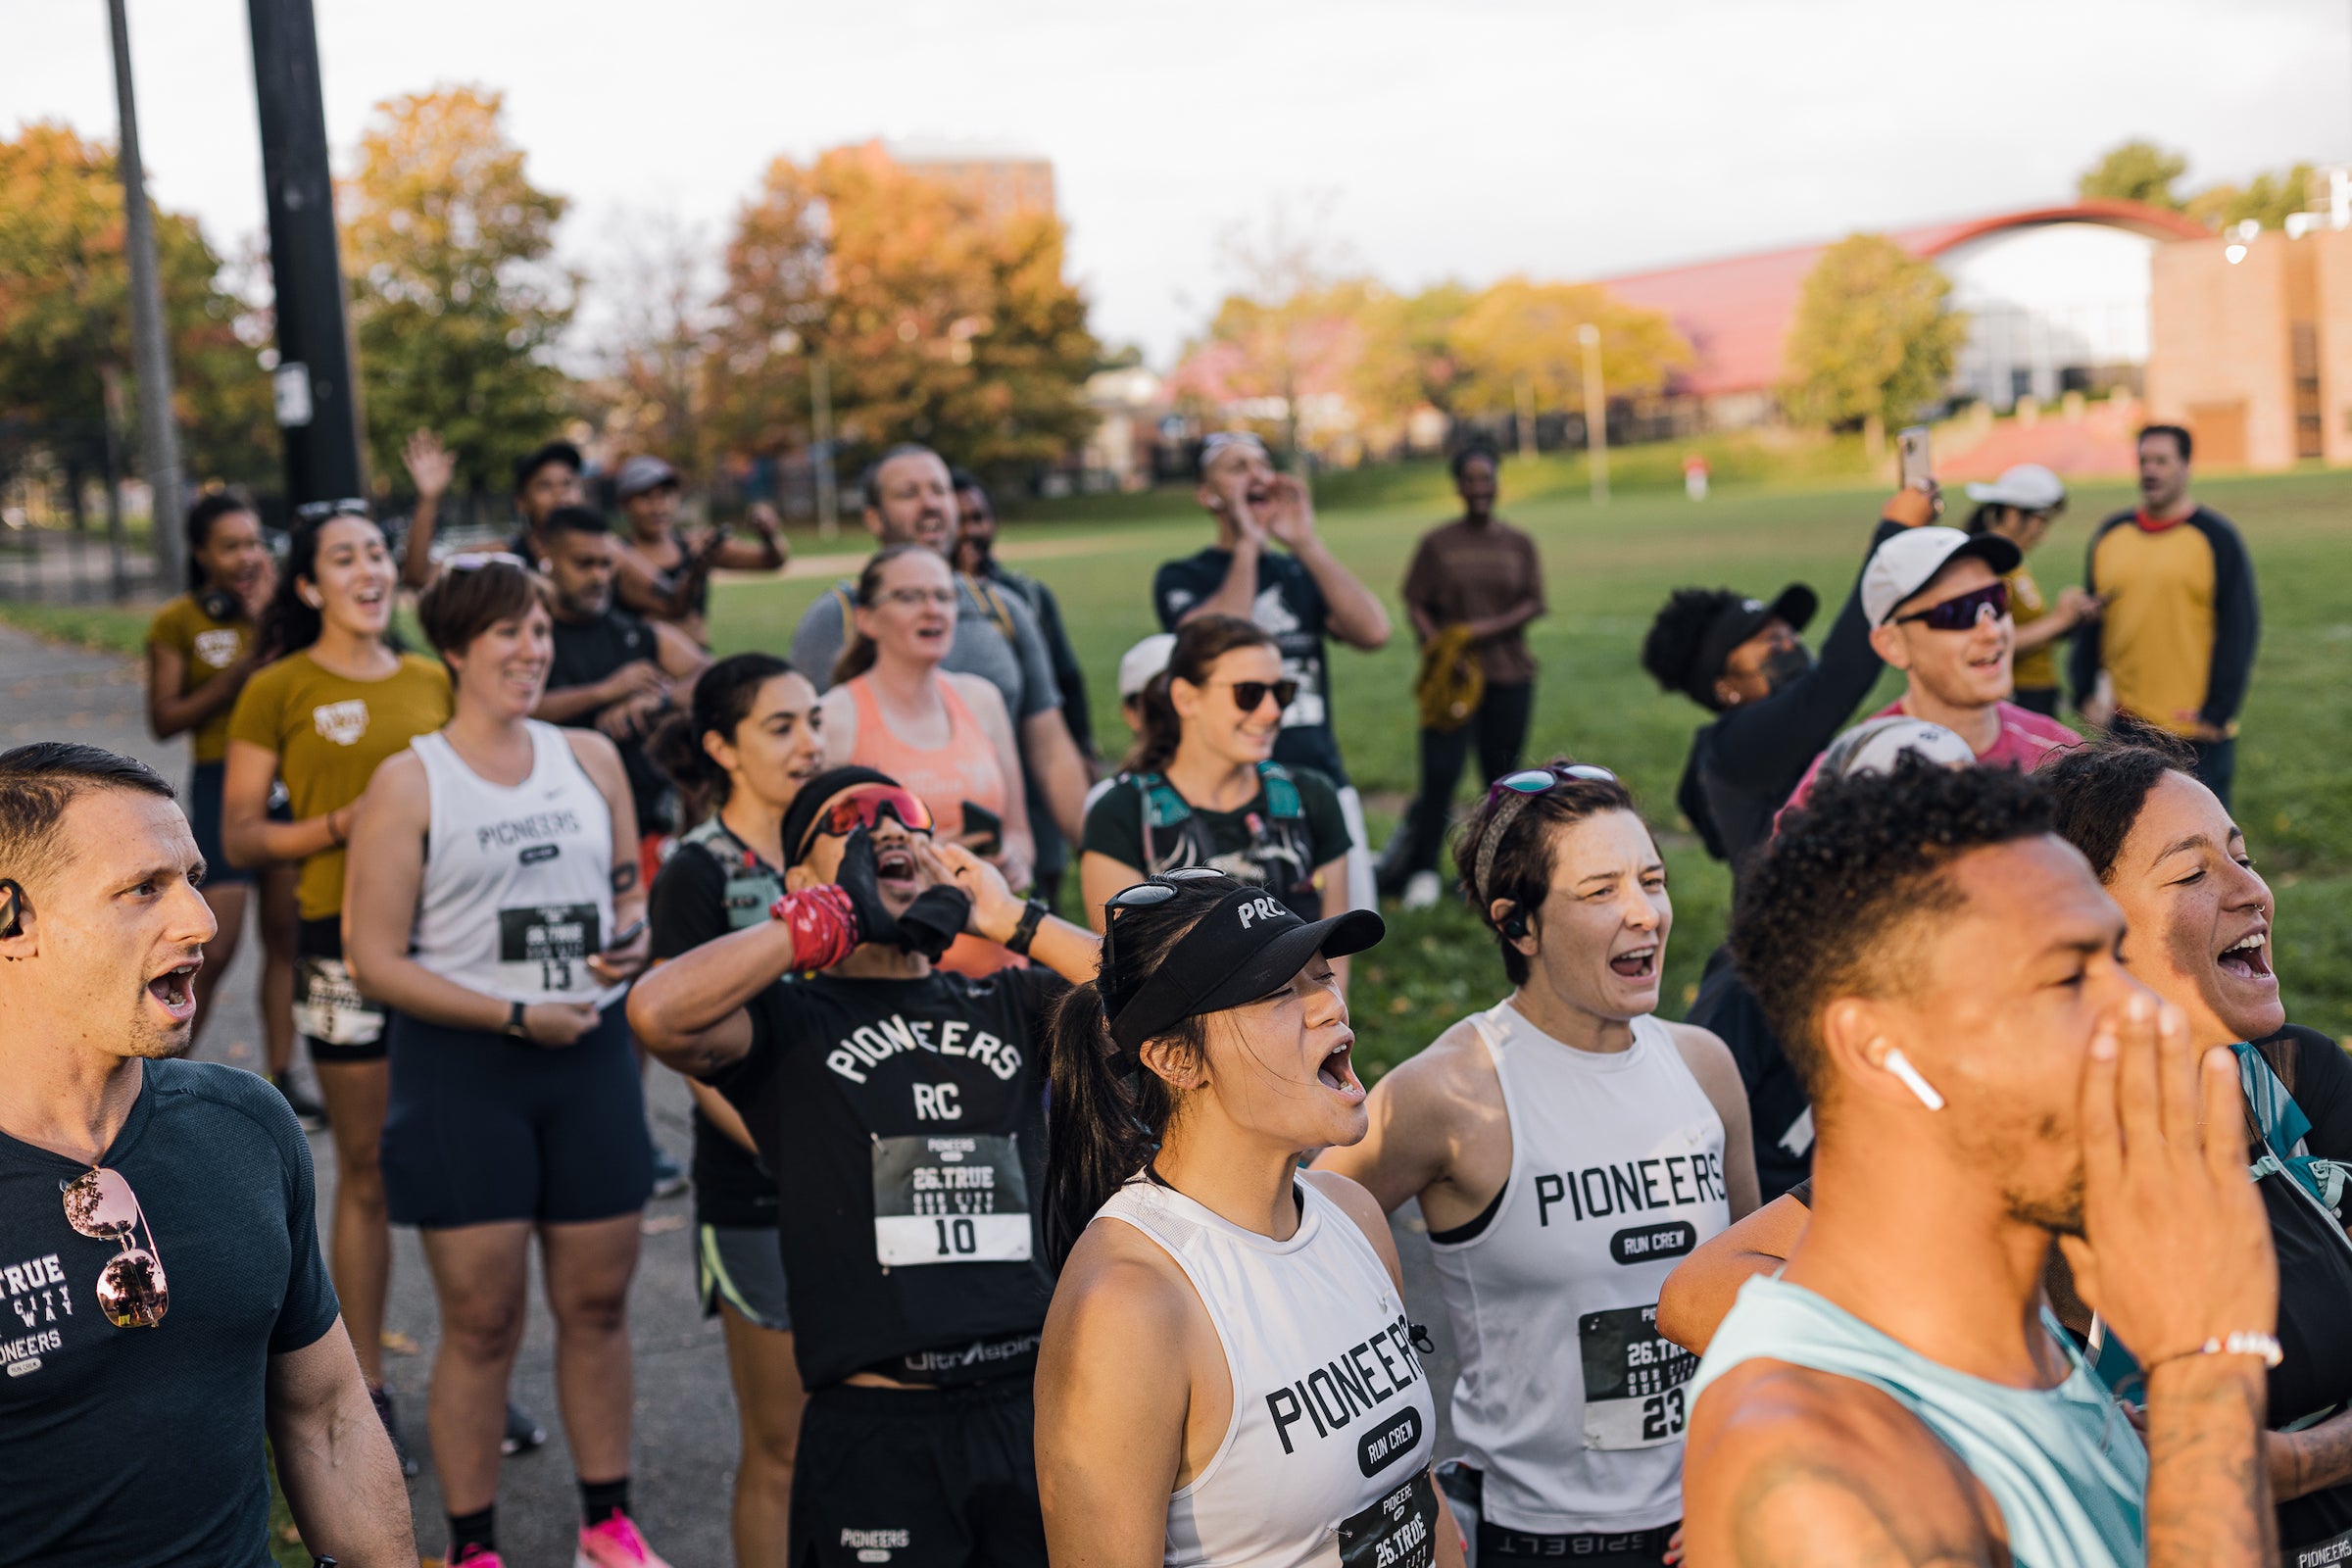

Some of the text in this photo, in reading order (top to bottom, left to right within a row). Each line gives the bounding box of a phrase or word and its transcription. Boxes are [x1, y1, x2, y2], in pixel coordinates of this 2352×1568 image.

[1238, 897, 1286, 929] PRC
[543, 960, 571, 991] 13
[826, 1013, 1022, 1085] PIONEERS
[912, 1082, 962, 1120] RC
[912, 1165, 995, 1191] 26.TRUE
[1535, 1153, 1727, 1228] PIONEERS
[935, 1218, 976, 1255] 10
[1623, 1229, 1686, 1255] RUN CREW
[1266, 1315, 1423, 1455] PIONEER
[1628, 1368, 1660, 1385] OUR
[1643, 1388, 1685, 1442] 23
[1367, 1420, 1414, 1464] RUN CREW
[1383, 1483, 1412, 1516] PIONEERS
[841, 1528, 910, 1548] PIONEERS
[1376, 1511, 1427, 1568] 26.TRUE
[2298, 1540, 2352, 1568] PIONEERS
